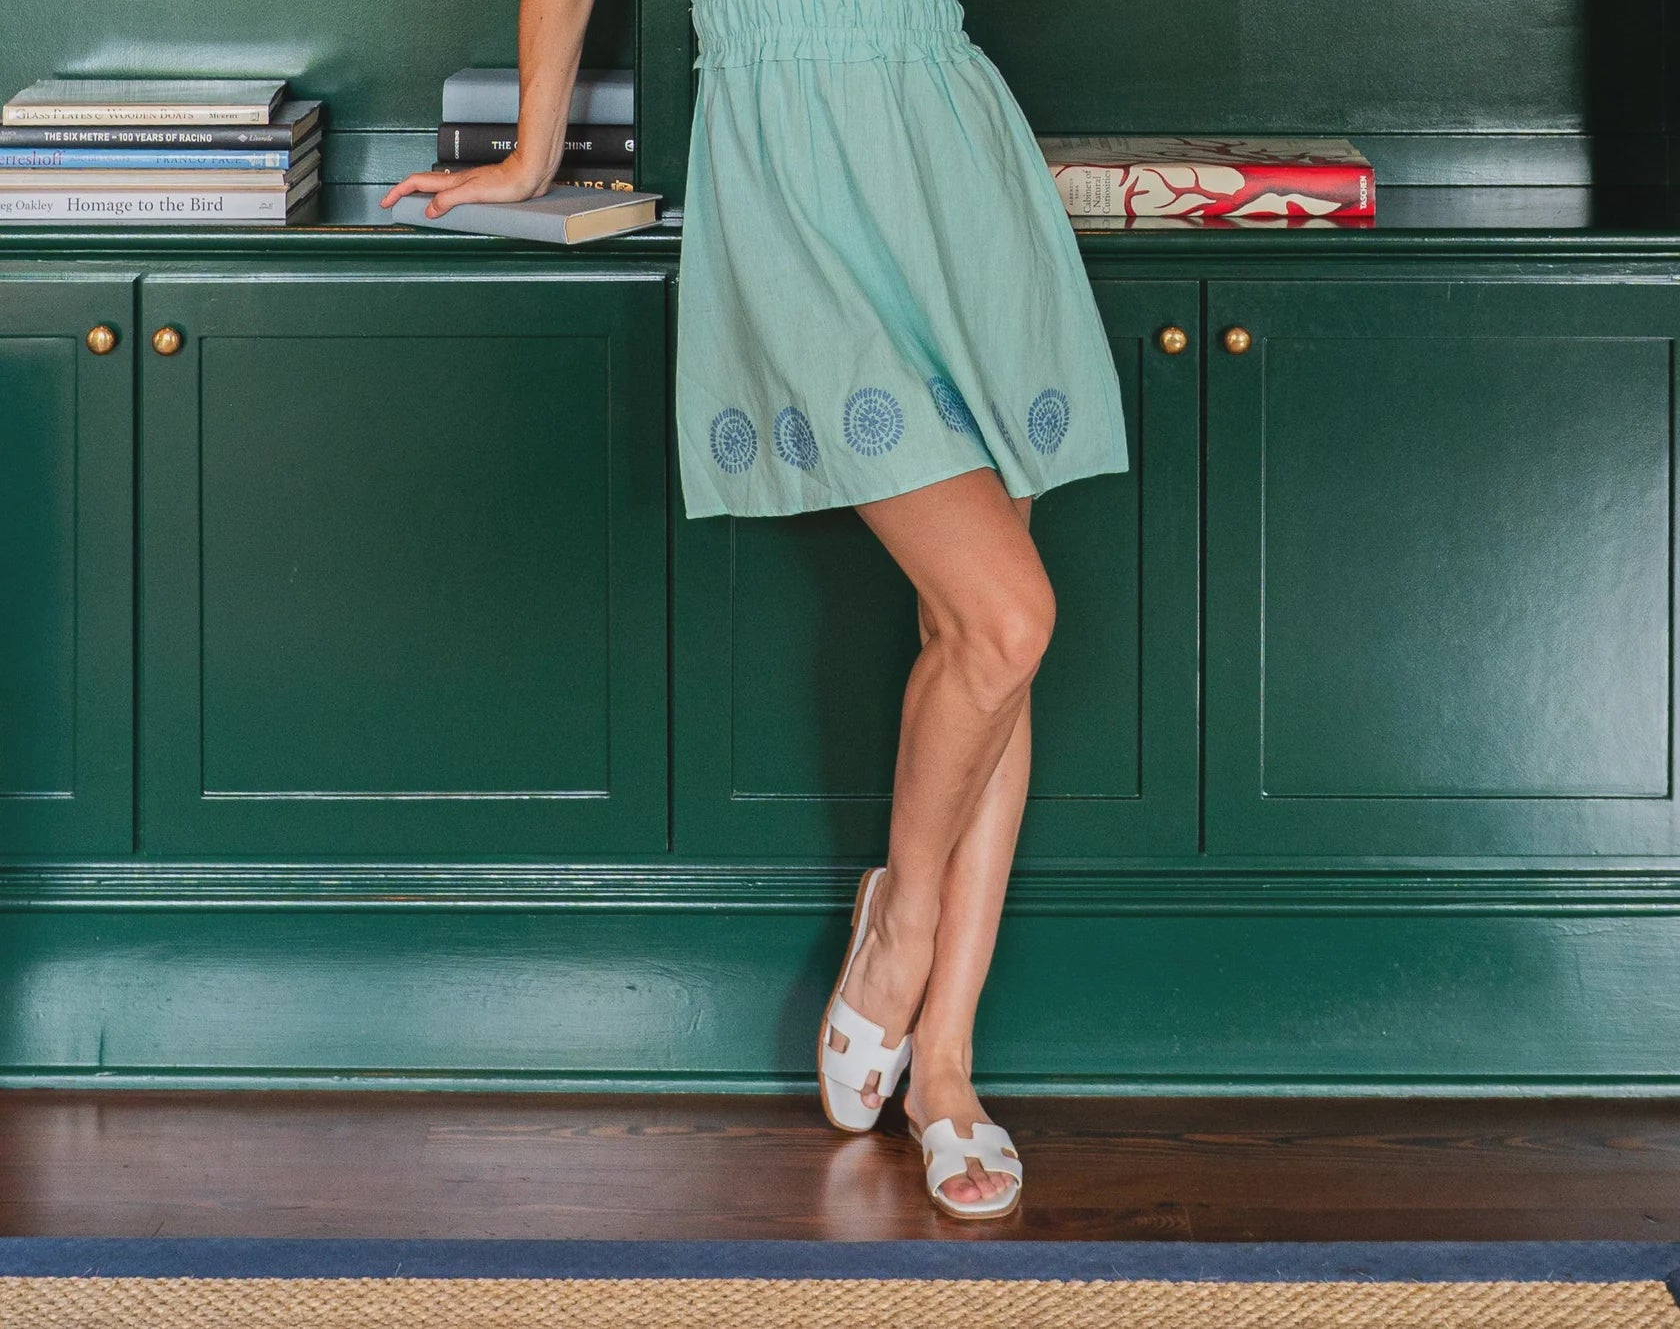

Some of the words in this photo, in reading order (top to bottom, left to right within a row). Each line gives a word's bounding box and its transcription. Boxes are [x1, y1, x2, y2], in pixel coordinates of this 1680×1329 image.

[44, 132, 62, 141] THE
[63, 132, 78, 141] SIX
[79, 132, 109, 142] METRE
[119, 132, 133, 142] 100
[135, 133, 164, 142] YEARS
[165, 133, 177, 142] OF
[179, 133, 213, 142] RACING
[492, 141, 511, 150] THE
[563, 141, 593, 150] CHINE
[0, 150, 66, 166] erreshoff
[1083, 169, 1092, 179] of
[1083, 180, 1091, 214] Cabinet
[1093, 176, 1102, 208] Natural
[1102, 170, 1111, 214] Curiosities
[1359, 175, 1368, 210] TASCHEN
[15, 200, 54, 213] Oakley
[67, 197, 133, 215] Homage
[138, 199, 153, 212] to
[159, 197, 185, 212] the
[190, 197, 223, 212] Bird
